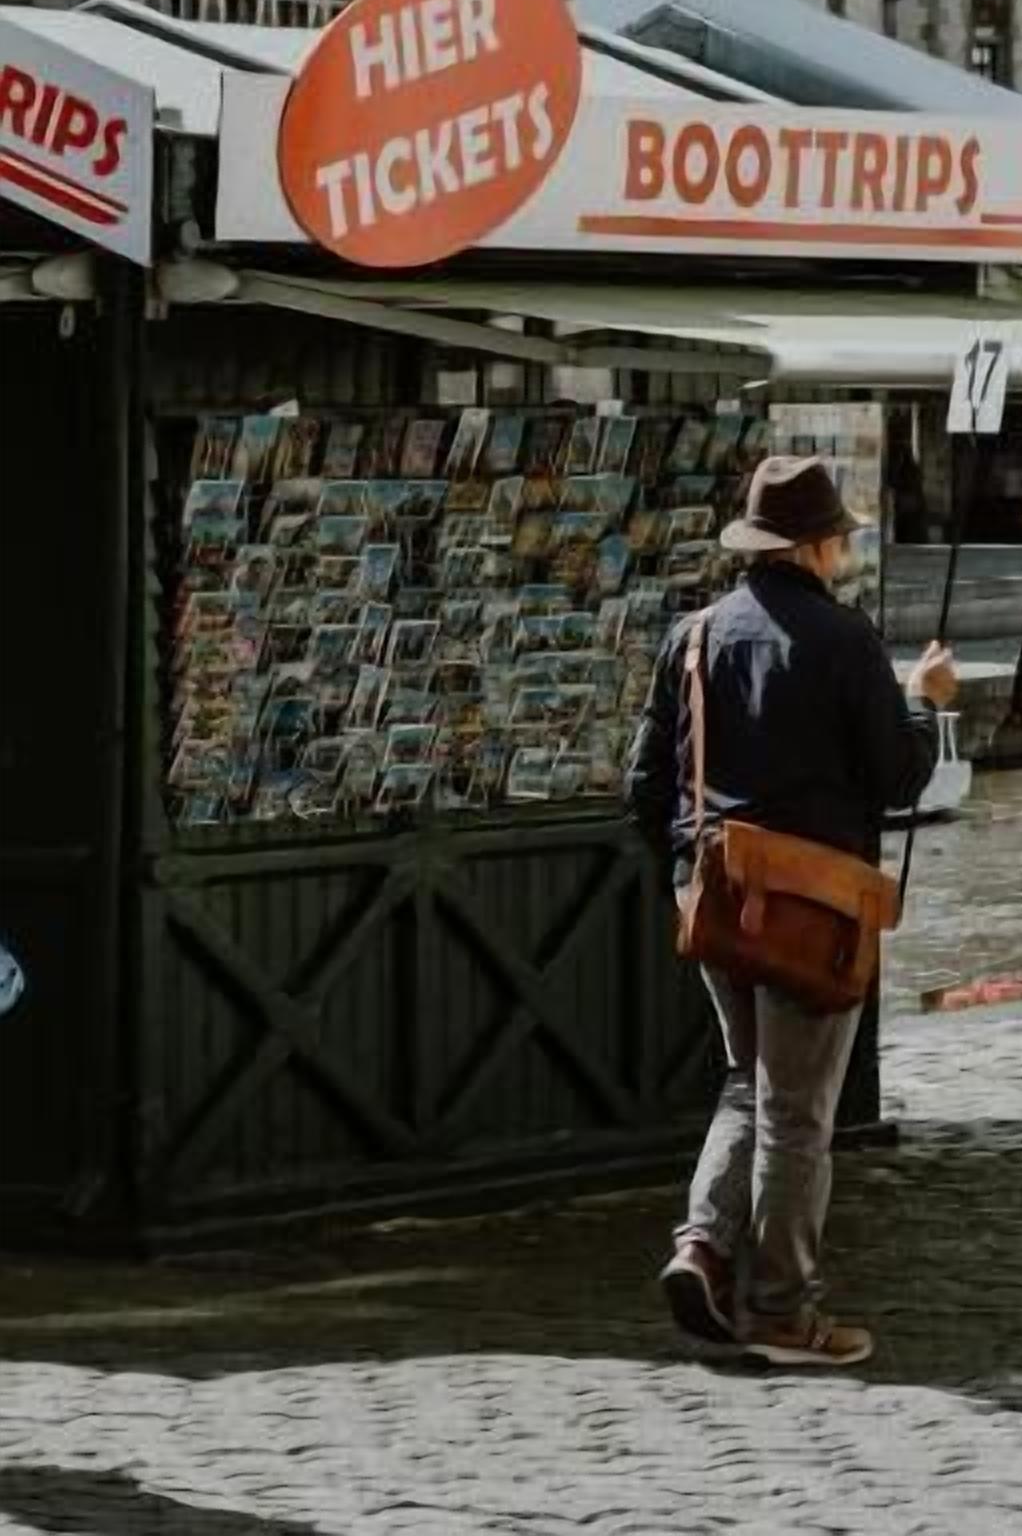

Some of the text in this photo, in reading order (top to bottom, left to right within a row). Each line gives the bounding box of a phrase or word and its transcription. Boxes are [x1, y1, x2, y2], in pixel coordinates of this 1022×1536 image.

[0, 65, 128, 177] RIPS
[315, 81, 554, 239] TICKETS
[623, 119, 982, 216] BOOTTRIPS
[964, 338, 1003, 402] 17
